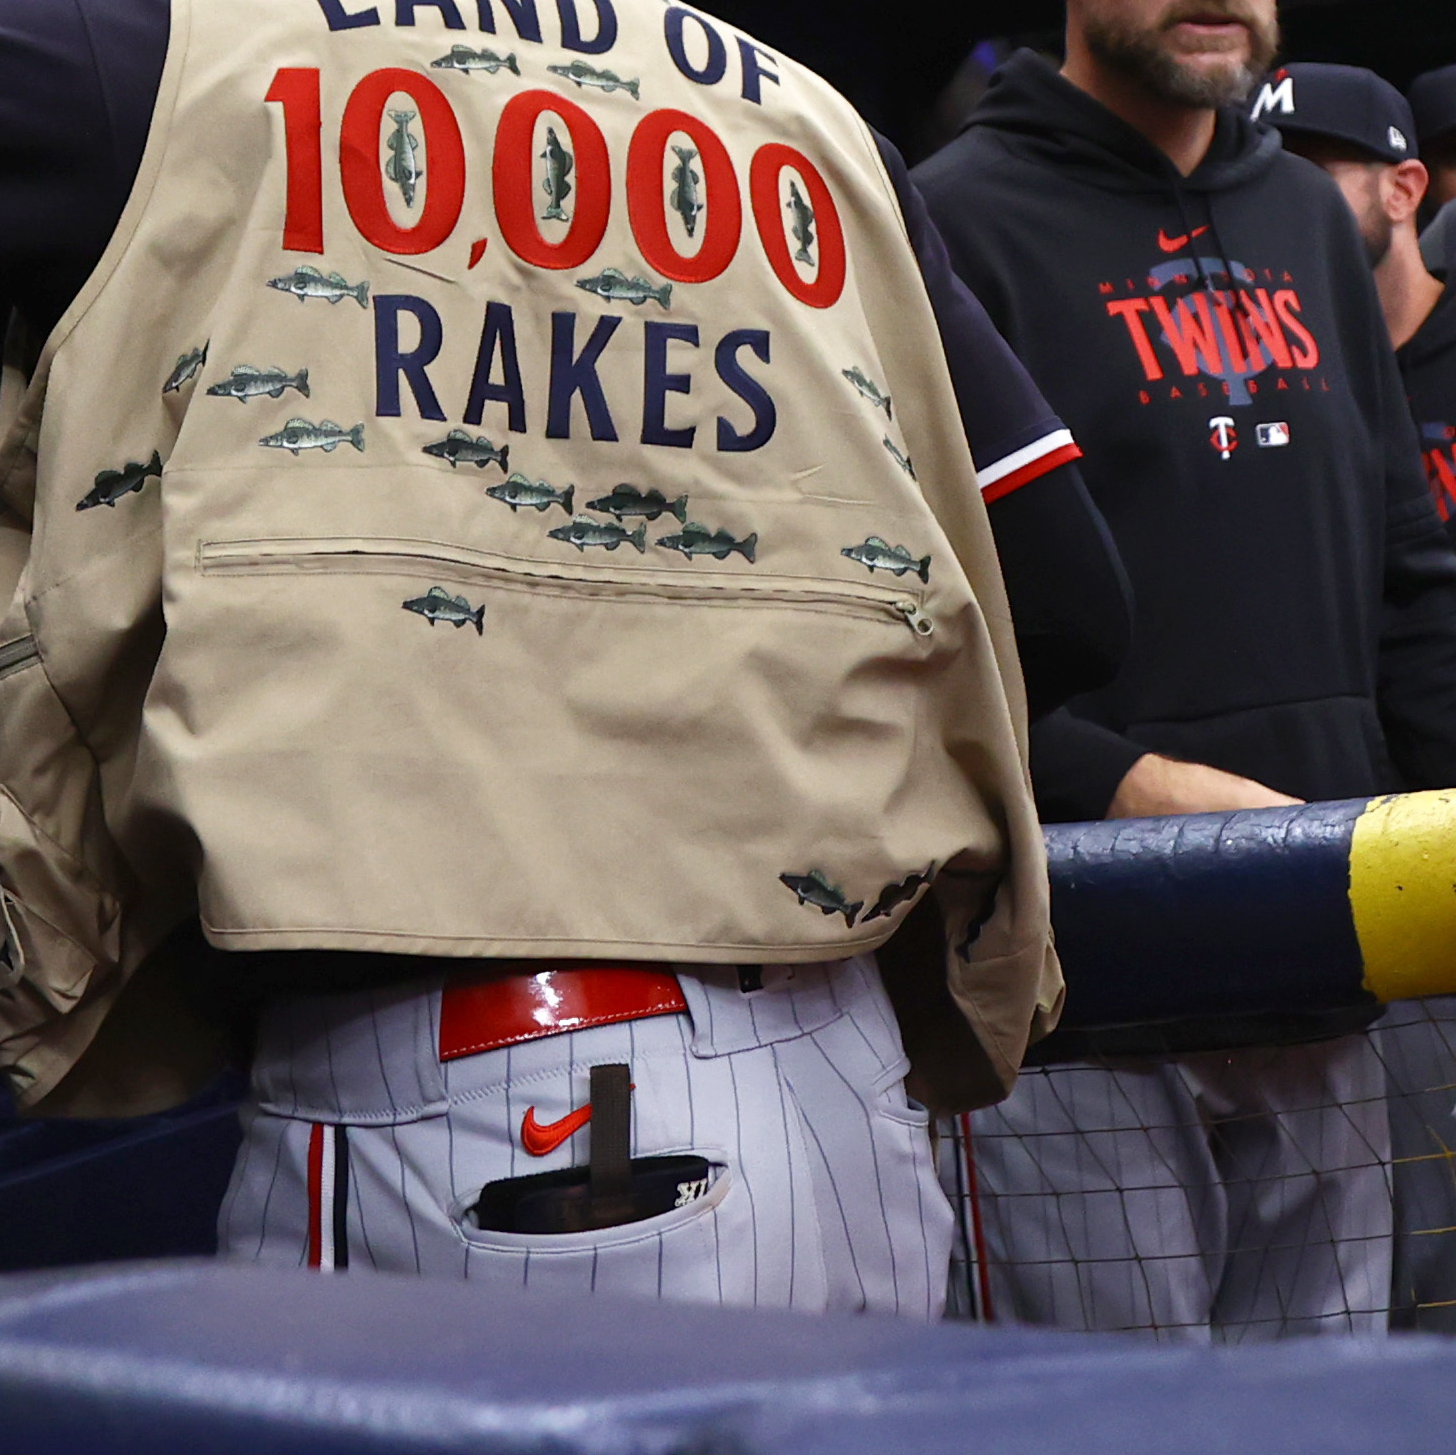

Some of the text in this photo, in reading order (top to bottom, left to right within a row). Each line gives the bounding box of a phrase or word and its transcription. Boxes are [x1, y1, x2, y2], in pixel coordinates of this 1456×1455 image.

[663, 6, 781, 106] OF
[263, 67, 846, 310] 10,000
[371, 293, 777, 453] RAKES
[1106, 288, 1320, 381] TWINS
